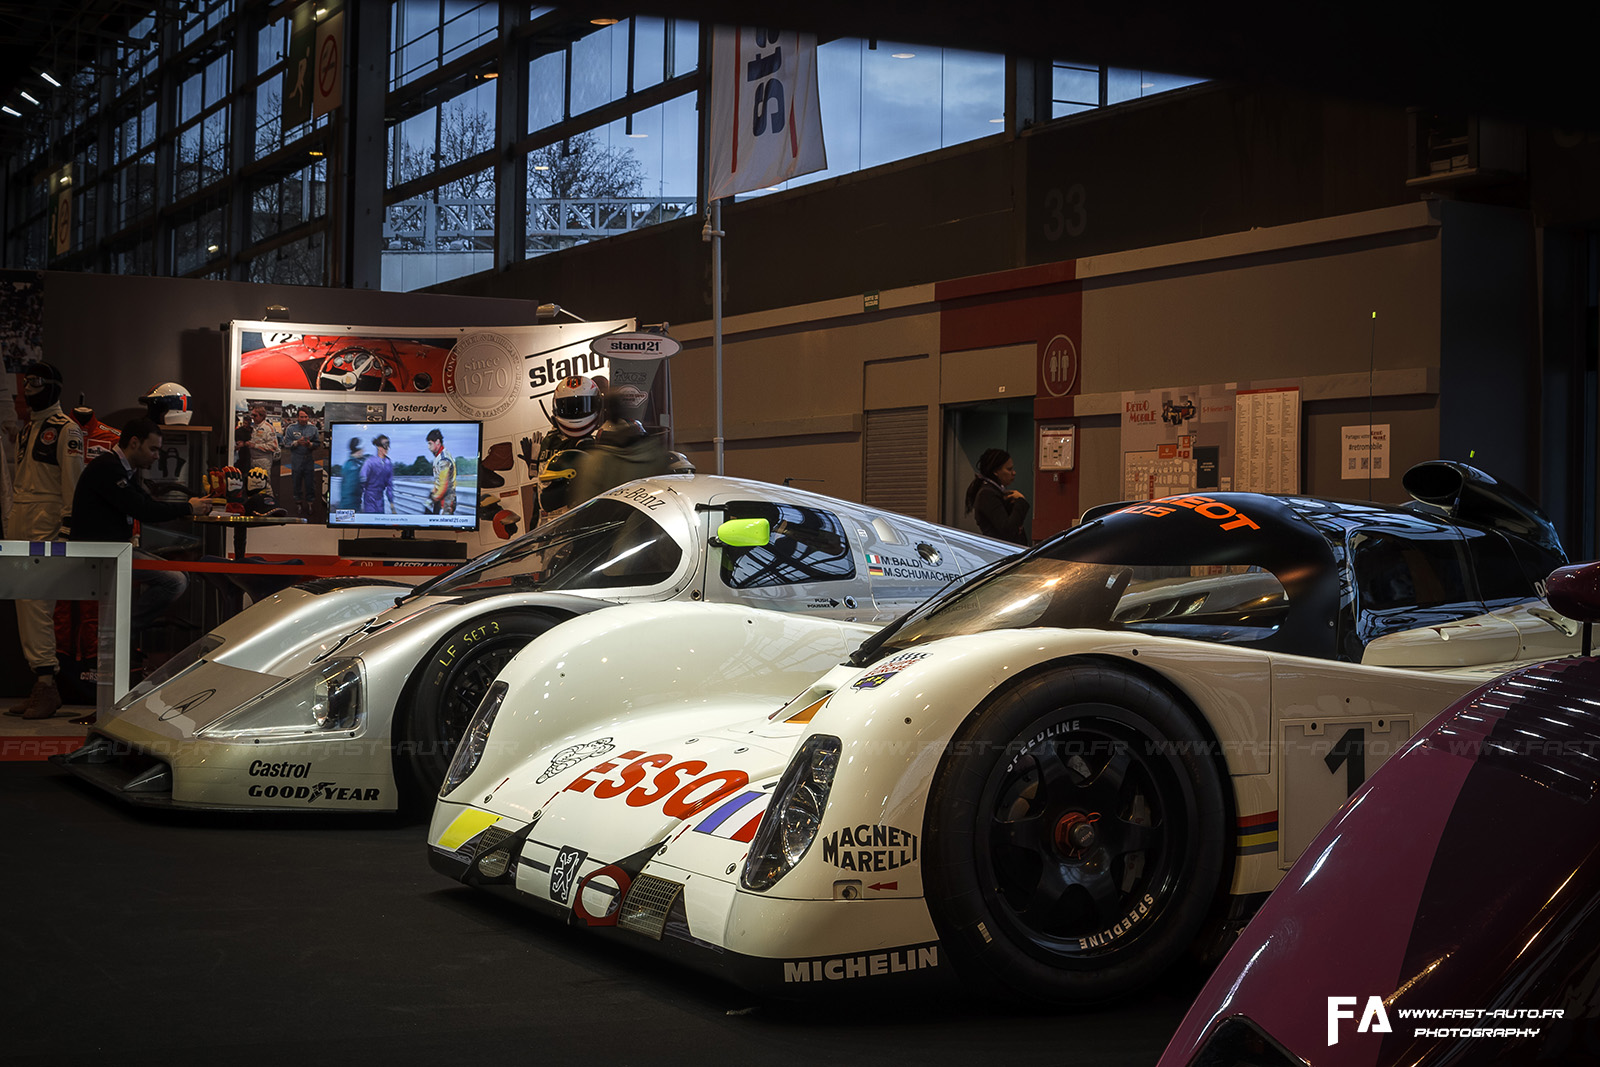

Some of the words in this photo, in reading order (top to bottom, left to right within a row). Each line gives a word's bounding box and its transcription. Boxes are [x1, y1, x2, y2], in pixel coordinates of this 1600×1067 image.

[1043, 183, 1087, 241] 33
[611, 341, 660, 351] stand21
[464, 357, 500, 371] since
[461, 367, 508, 396] 1970
[392, 403, 448, 415] Yesterday's
[439, 644, 457, 667] LF
[463, 625, 486, 645] SET
[491, 621, 500, 634] 3
[249, 759, 312, 779] Castrol
[563, 749, 749, 820] ESSO
[822, 824, 918, 860] MAGNETI
[826, 848, 918, 872] MARELLI
[1079, 893, 1154, 950] SPEEDLINE
[783, 946, 940, 983] MICHELIN
